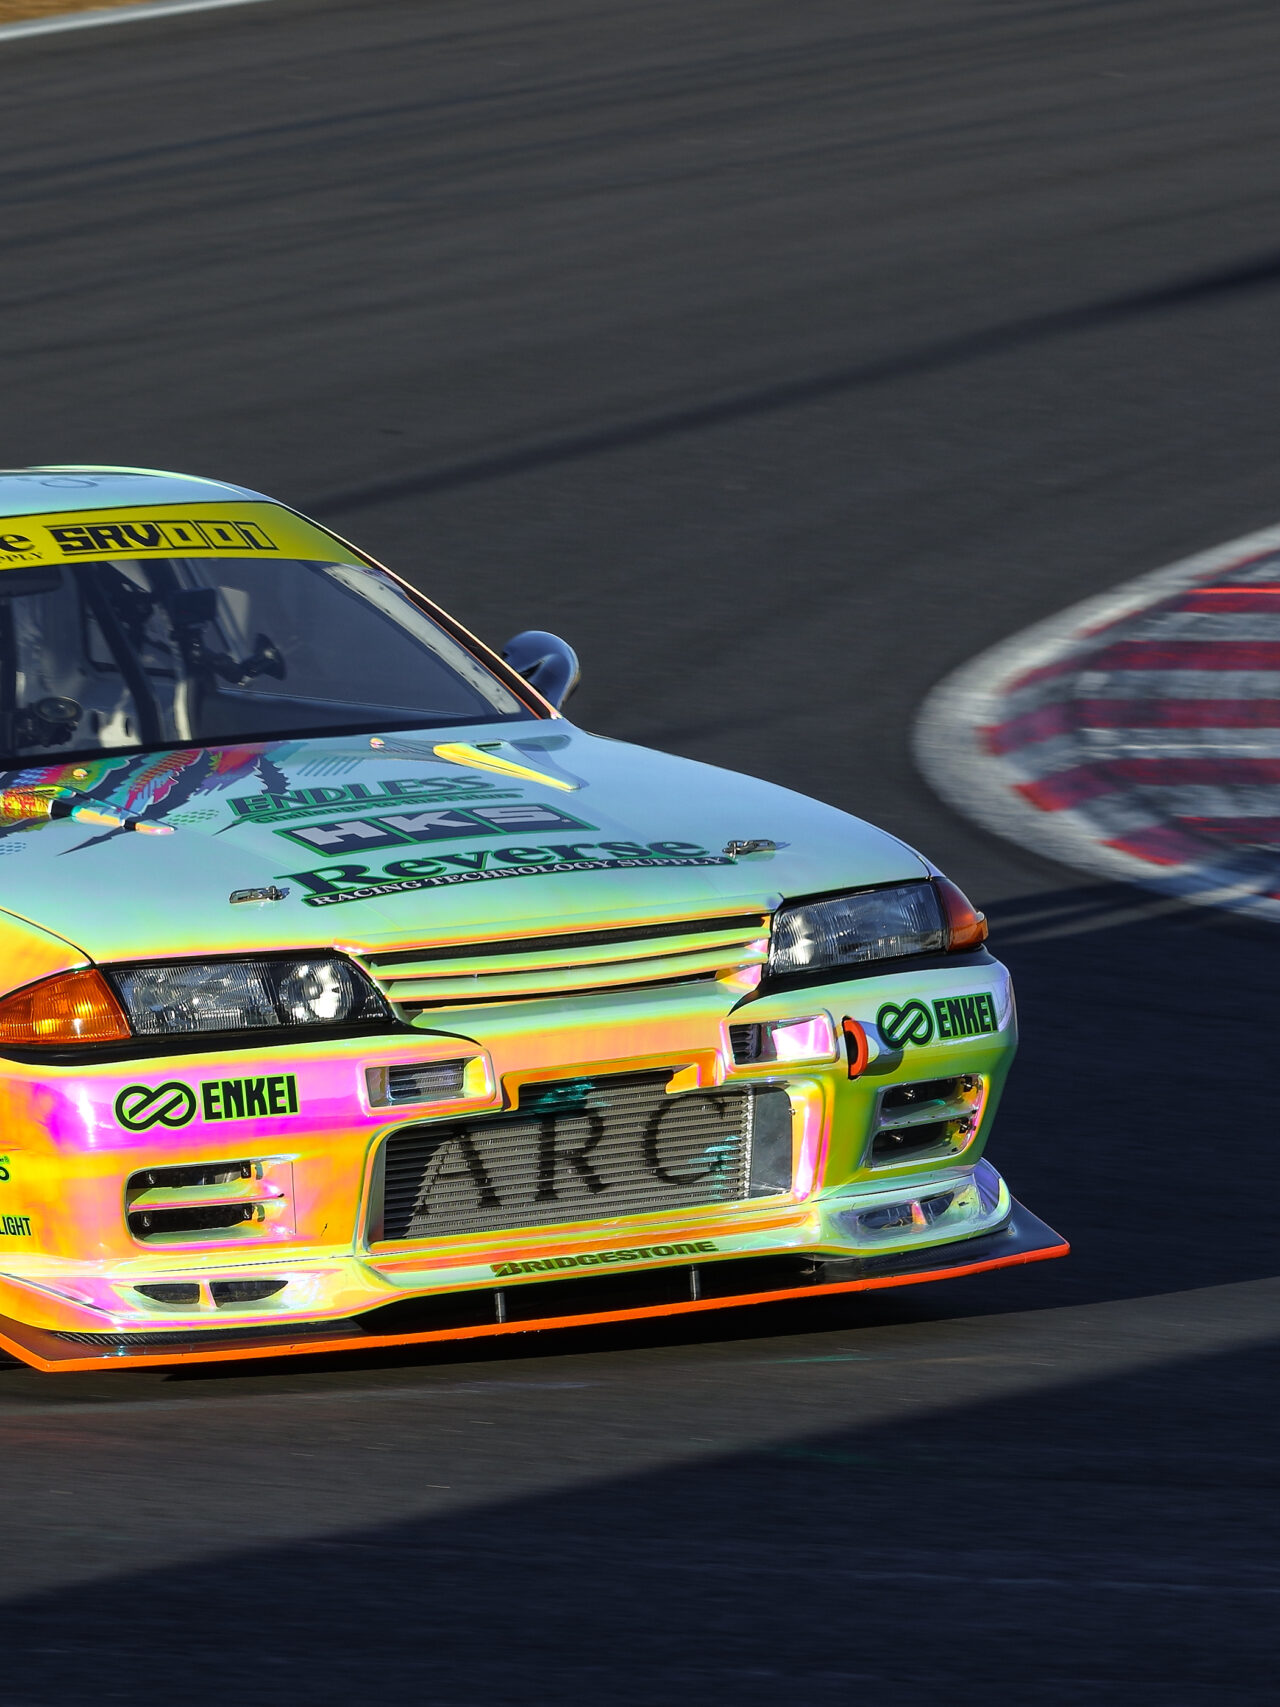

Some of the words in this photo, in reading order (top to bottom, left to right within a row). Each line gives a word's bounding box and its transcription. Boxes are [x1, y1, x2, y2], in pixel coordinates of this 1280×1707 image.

[230, 776, 495, 817] ENDLESS
[286, 804, 568, 849] HKS
[276, 840, 709, 896] Reverse
[311, 880, 421, 906] RACING
[425, 860, 609, 886] TECHNOLOGY
[616, 856, 724, 868] SUPPLY
[933, 993, 998, 1039] ENKEI
[202, 1075, 298, 1120] ENKEI
[413, 1092, 728, 1215] ARC
[491, 1240, 719, 1277] BRIDGESTONE
